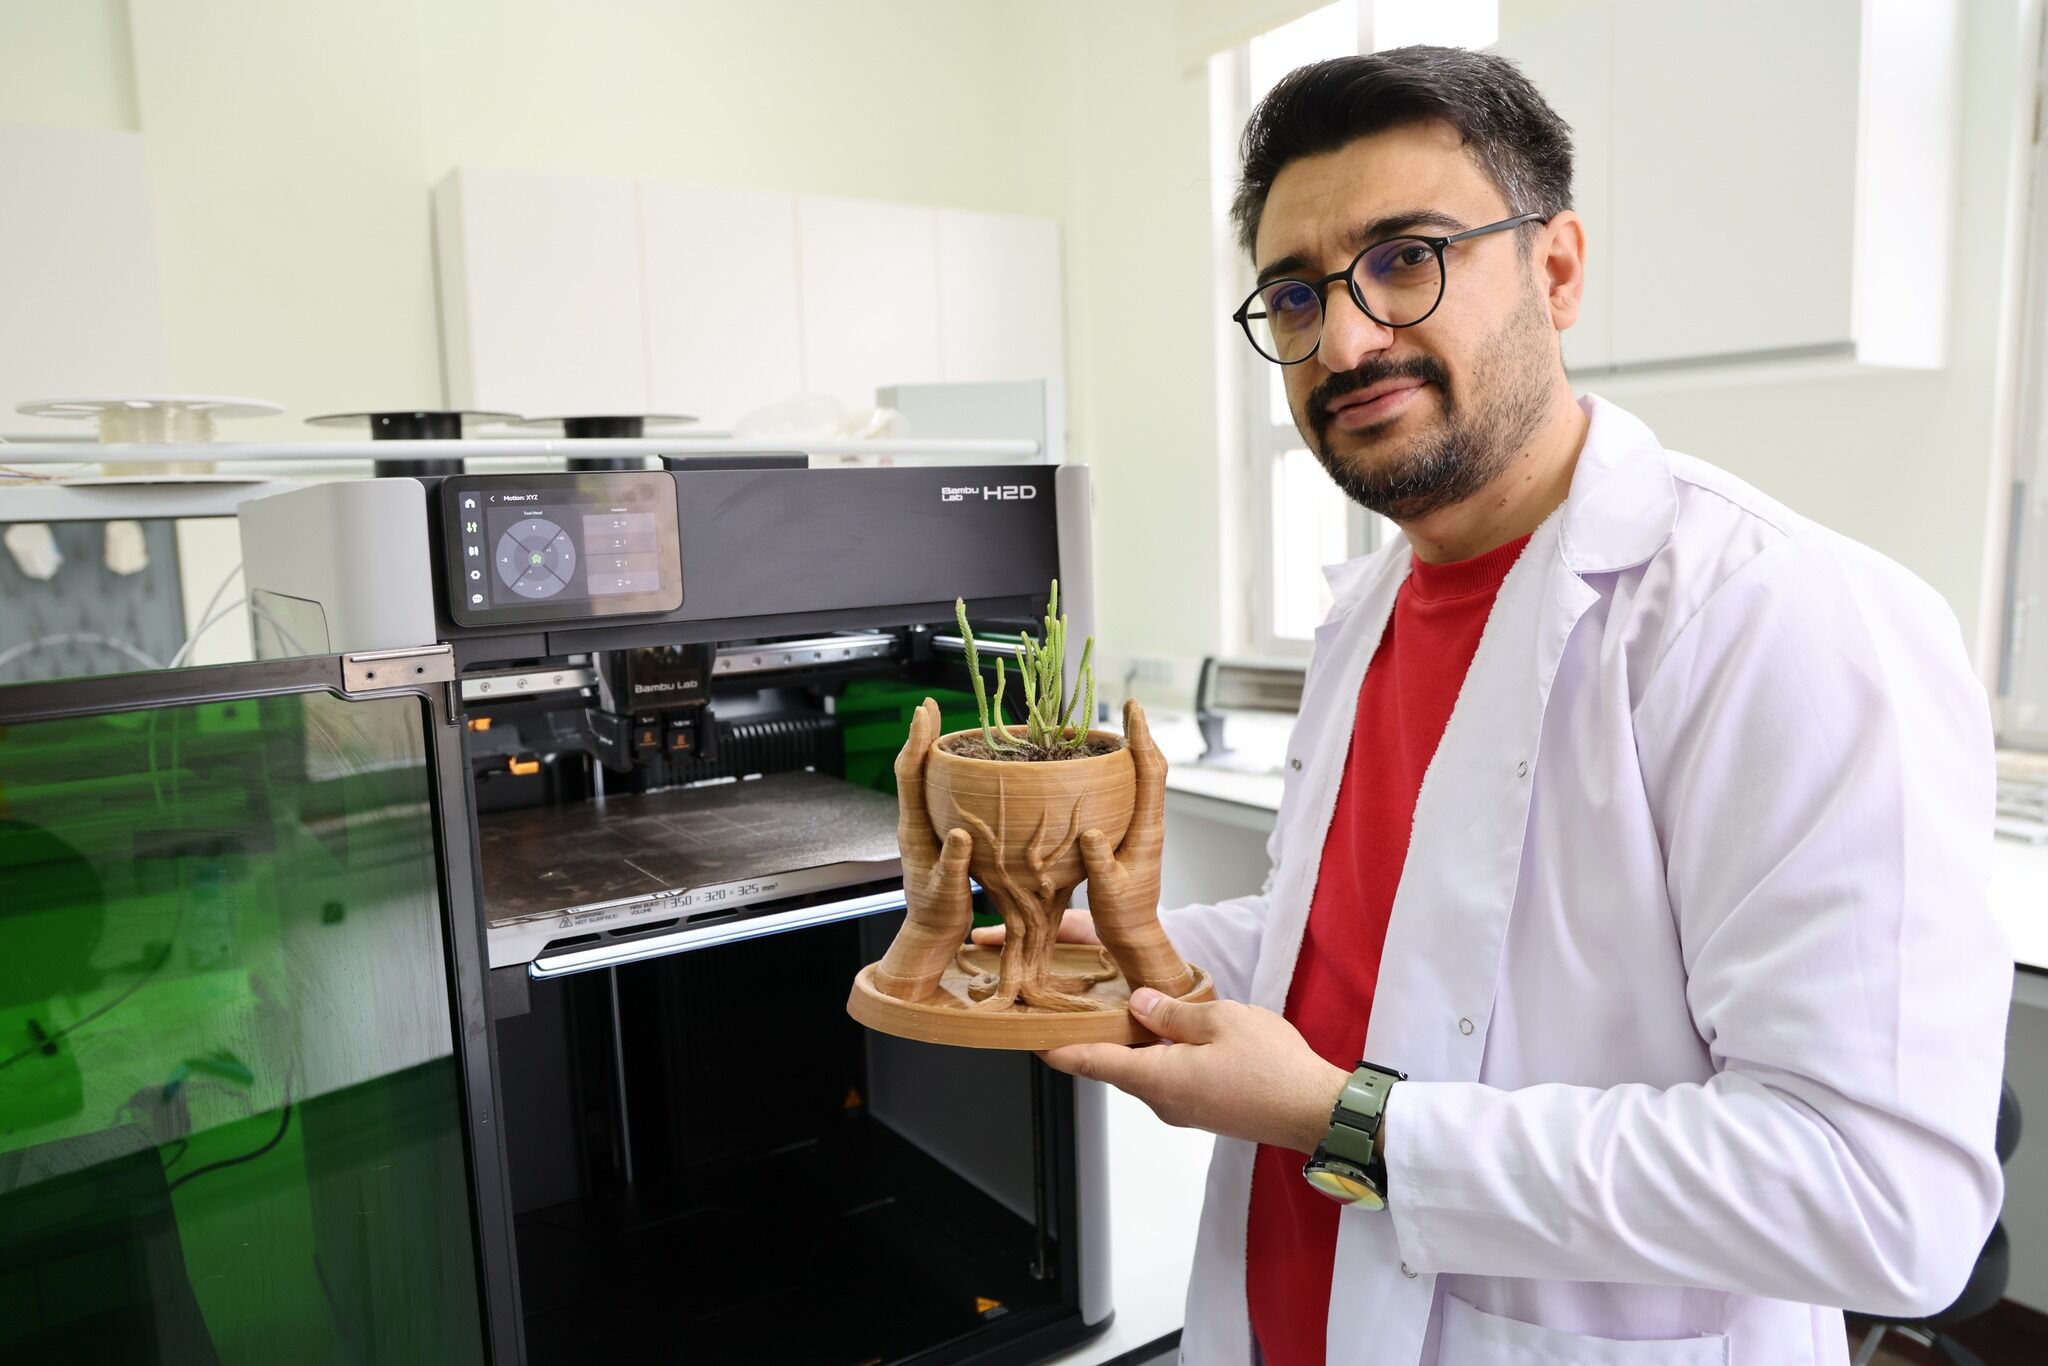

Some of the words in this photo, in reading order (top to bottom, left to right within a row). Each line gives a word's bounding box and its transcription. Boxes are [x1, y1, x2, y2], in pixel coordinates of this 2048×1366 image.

[983, 485, 1037, 500] H2D
[635, 683, 675, 693] Bambu
[677, 680, 698, 689] Lab
[670, 895, 692, 908] 350
[705, 890, 726, 902] 320
[738, 883, 759, 896] 325
